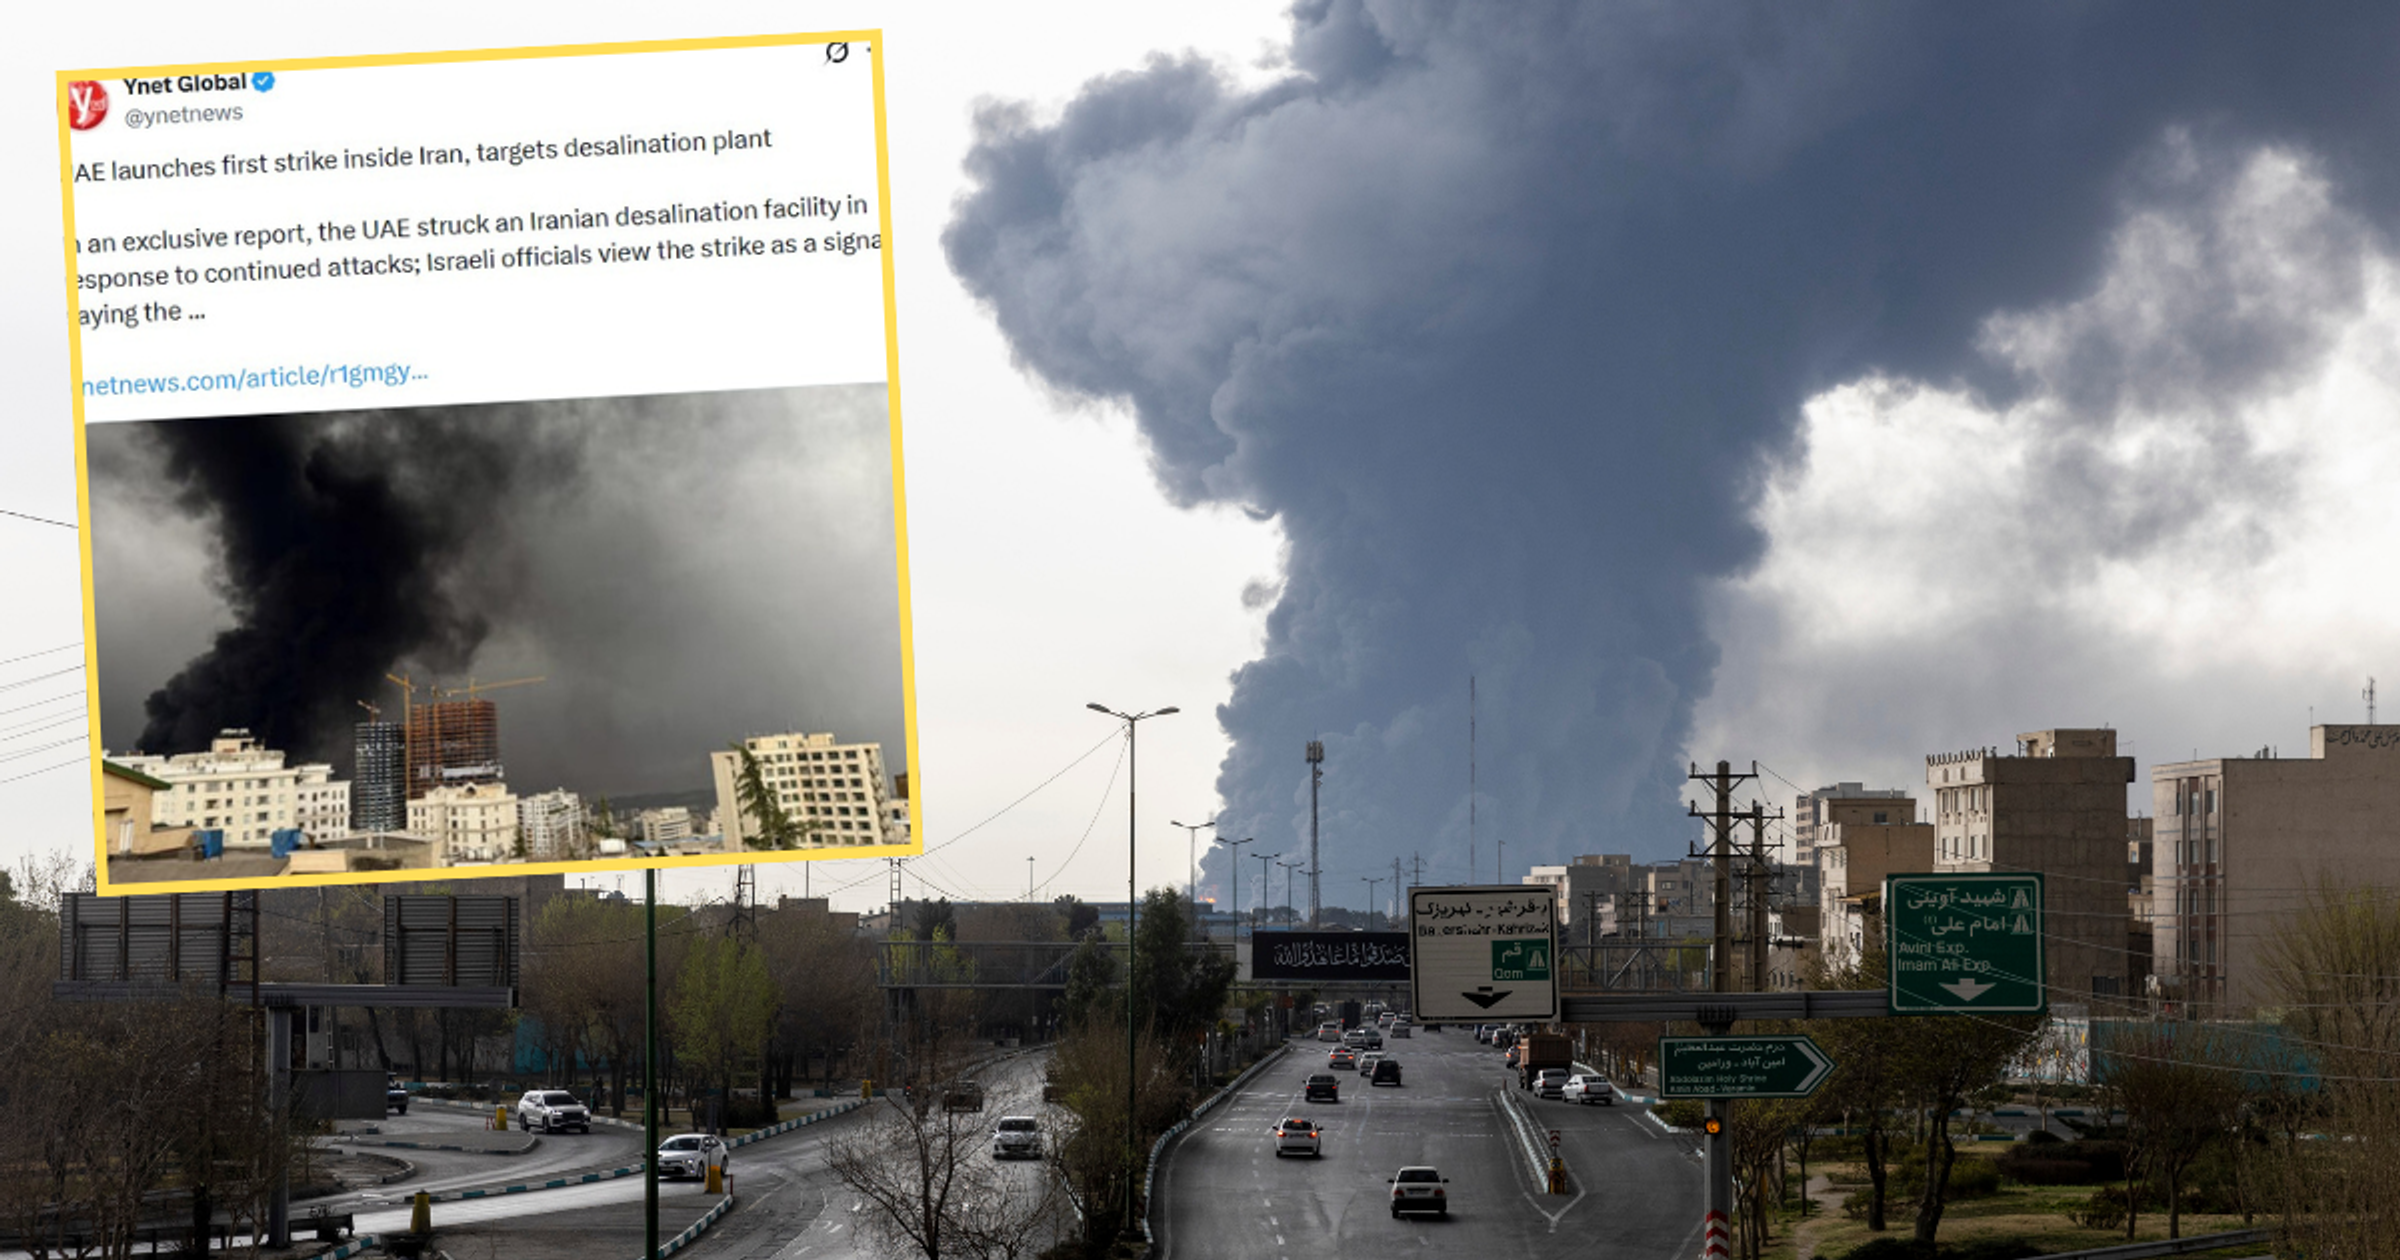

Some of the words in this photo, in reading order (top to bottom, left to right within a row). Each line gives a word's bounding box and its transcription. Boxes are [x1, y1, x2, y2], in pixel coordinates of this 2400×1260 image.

[1907, 887, 1957, 911] آوینی
[1960, 888, 2006, 907] شهید
[1970, 915, 2006, 937] امام
[1501, 941, 1522, 964] قم
[1899, 942, 1932, 954] Avini
[1936, 941, 1970, 956] Exp.
[1494, 968, 1524, 980] Qom
[1898, 958, 1937, 972] Imam
